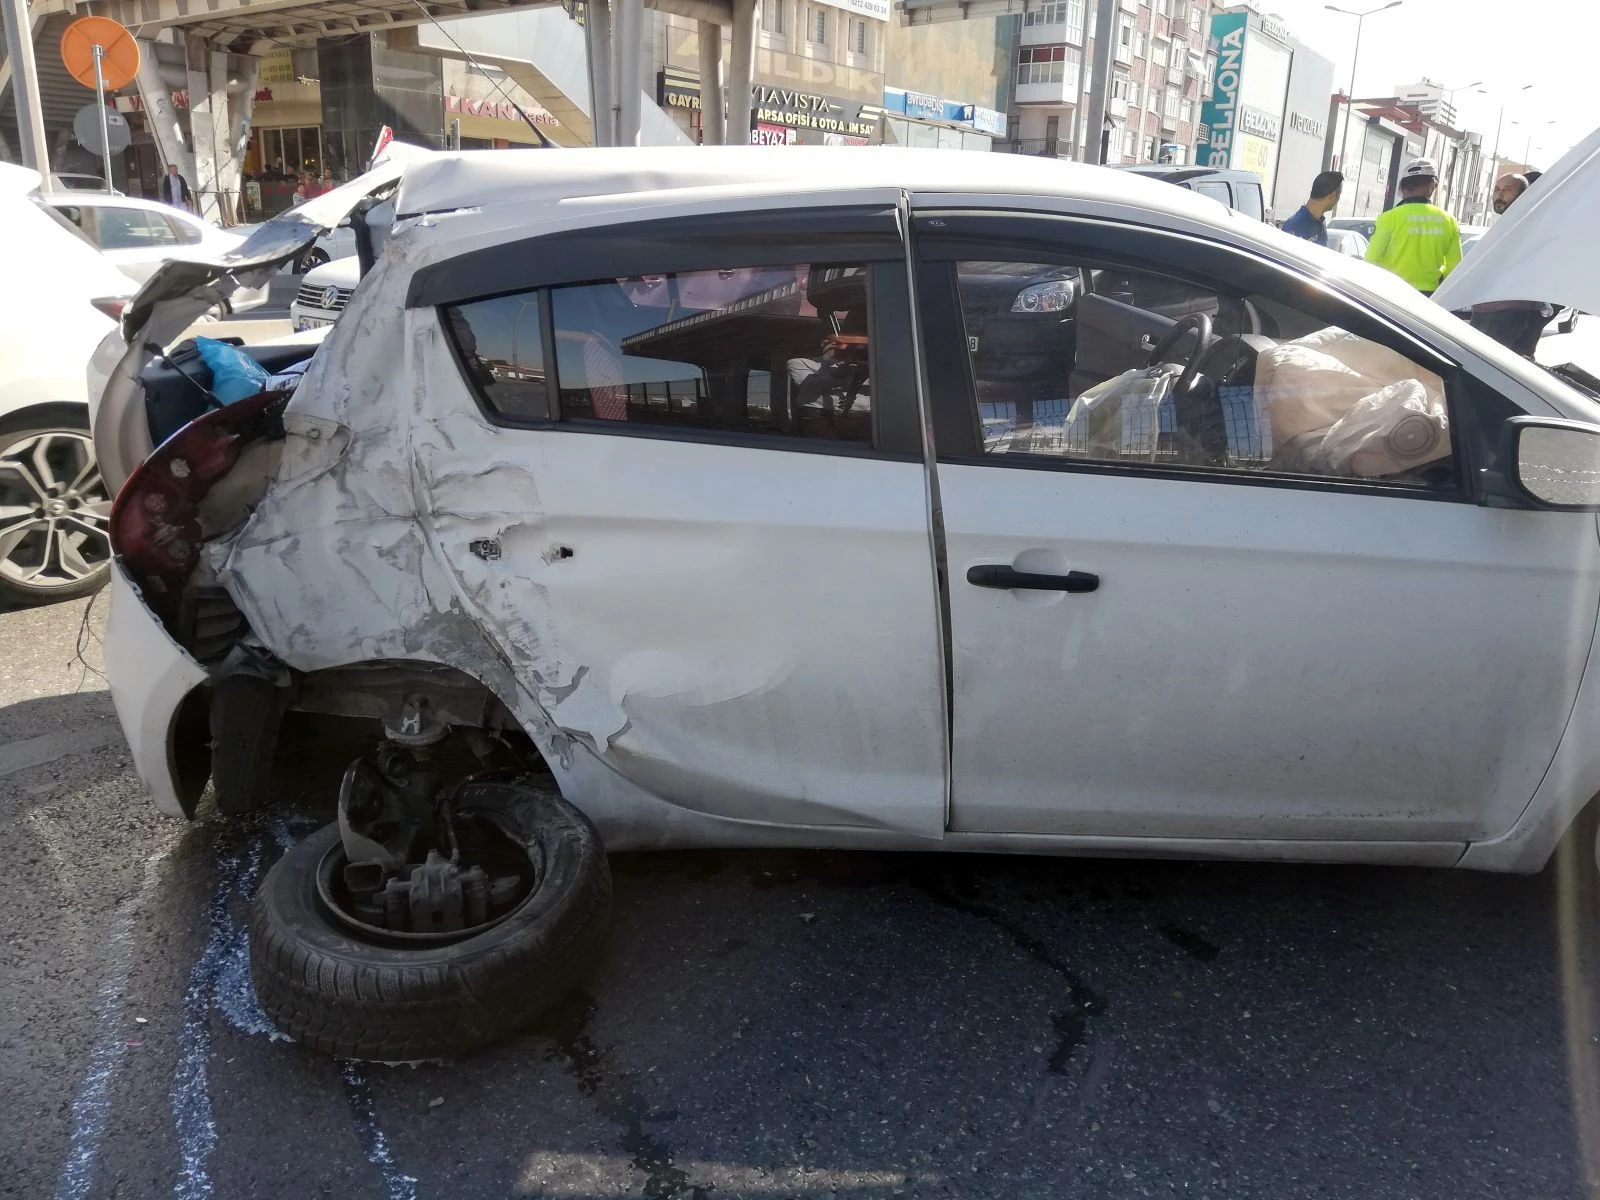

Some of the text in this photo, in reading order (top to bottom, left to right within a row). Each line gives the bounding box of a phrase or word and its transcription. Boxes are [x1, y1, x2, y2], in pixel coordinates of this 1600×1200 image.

[757, 108, 785, 122] ARSA
[819, 119, 838, 130] OTO
[1208, 27, 1244, 168] BELLONA
